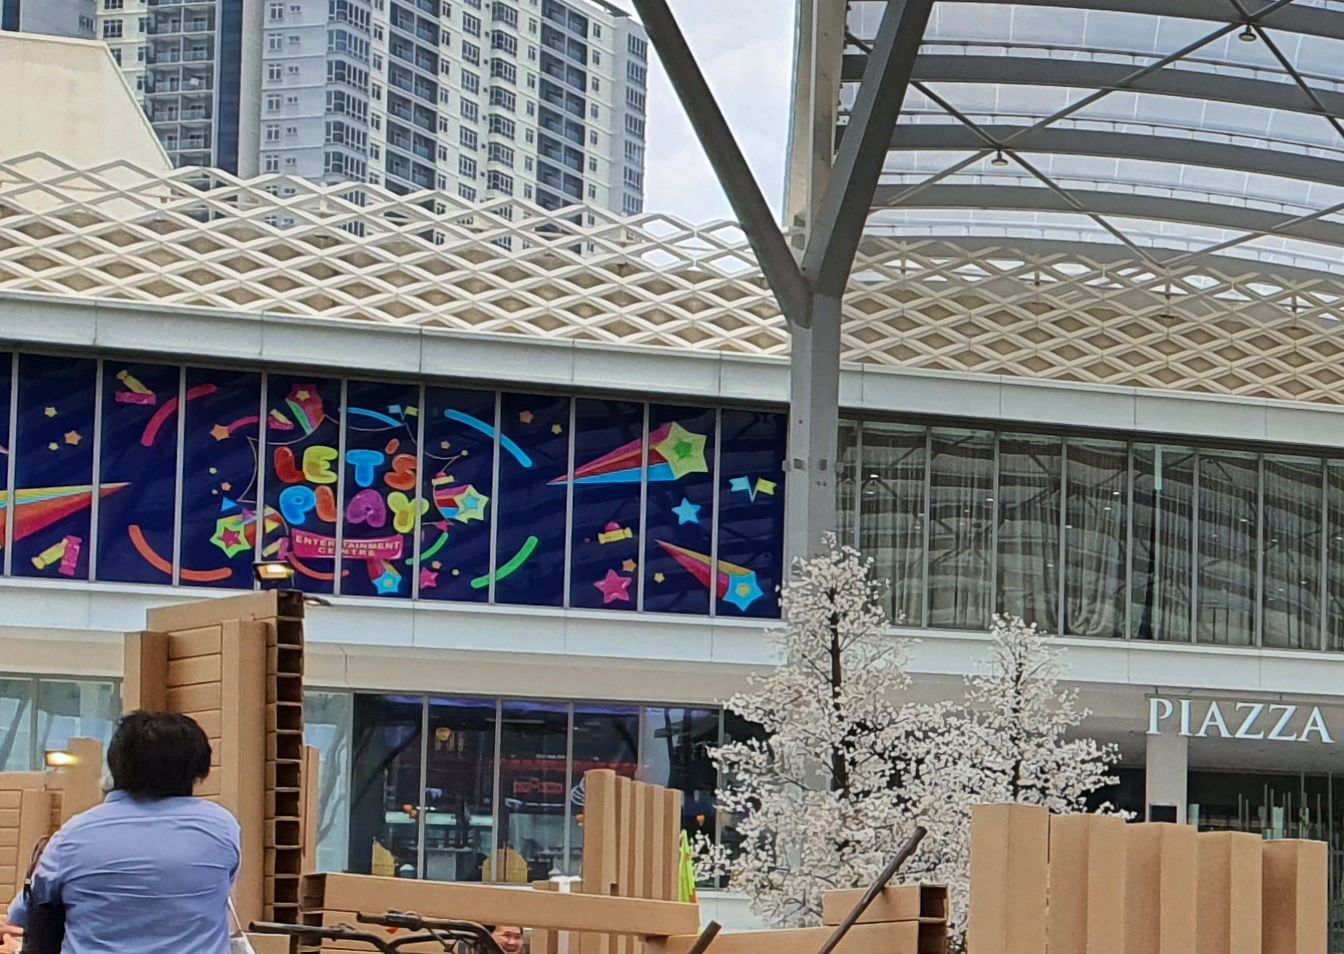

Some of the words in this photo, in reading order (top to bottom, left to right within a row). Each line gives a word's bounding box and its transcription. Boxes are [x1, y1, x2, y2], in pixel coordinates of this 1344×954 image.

[274, 438, 417, 490] LET'S
[279, 485, 429, 533] PLAY
[294, 535, 401, 550] ENTERTAINMENT
[318, 547, 376, 556] CENTRE
[1145, 698, 1334, 744] PIAZZA
